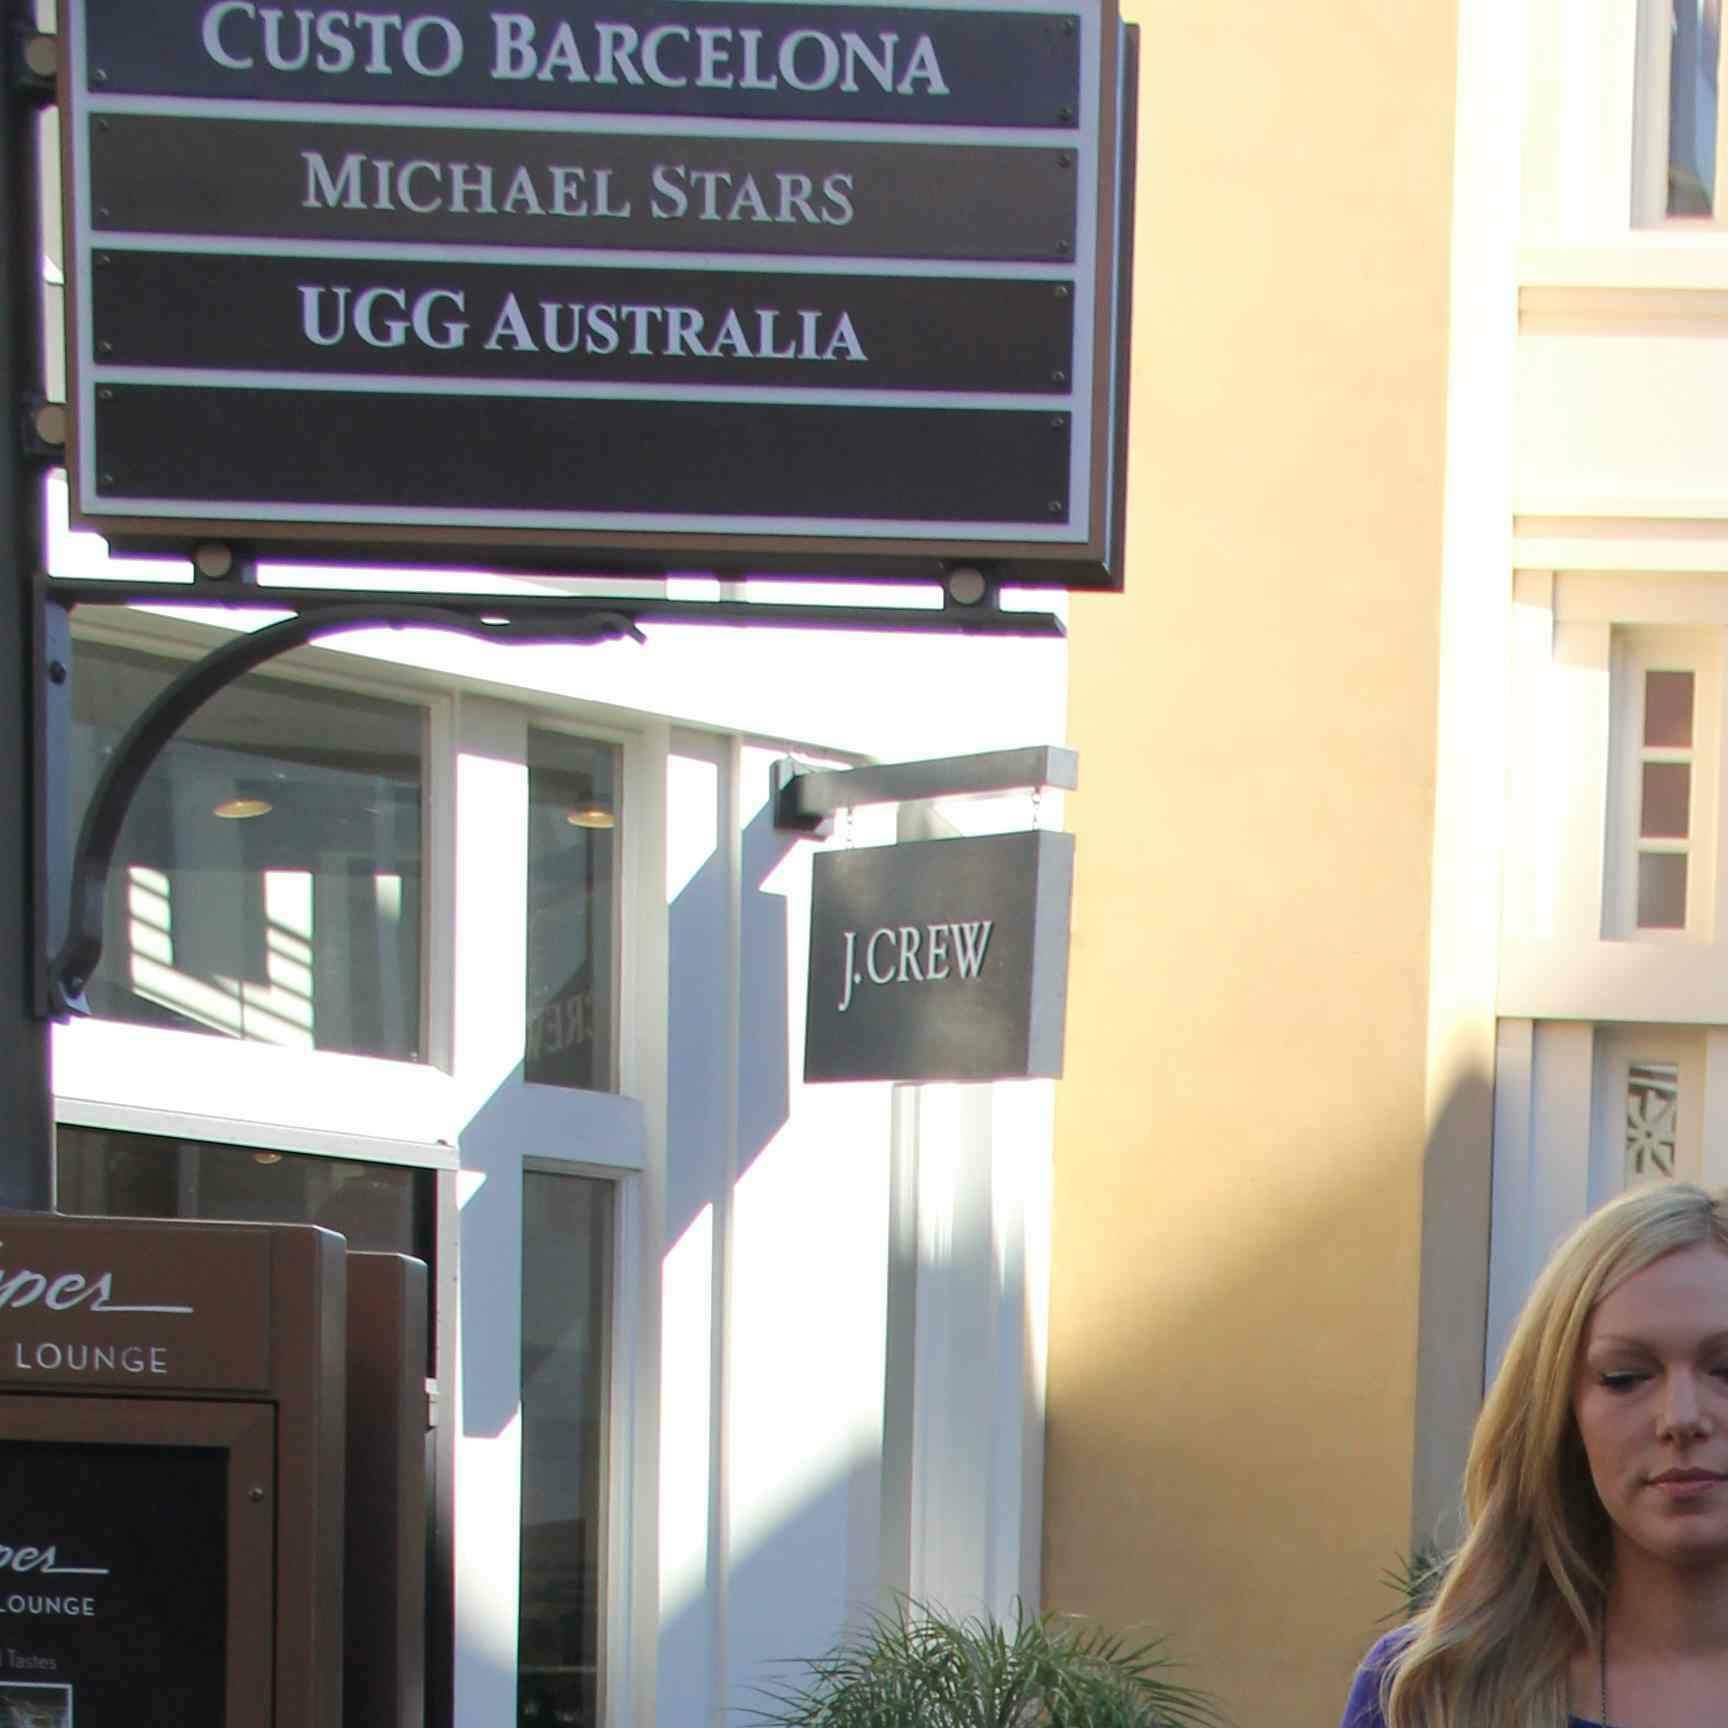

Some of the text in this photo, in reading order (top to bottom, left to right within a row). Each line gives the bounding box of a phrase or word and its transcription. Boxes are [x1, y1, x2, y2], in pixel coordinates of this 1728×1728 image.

[202, 0, 950, 96] CUSTO BARCELONA
[301, 150, 855, 226] MICHAEL STARS
[297, 285, 868, 362] UGG AUSTRALIA
[837, 919, 994, 1012] J.CREW
[15, 1342, 169, 1374] LOUNGE
